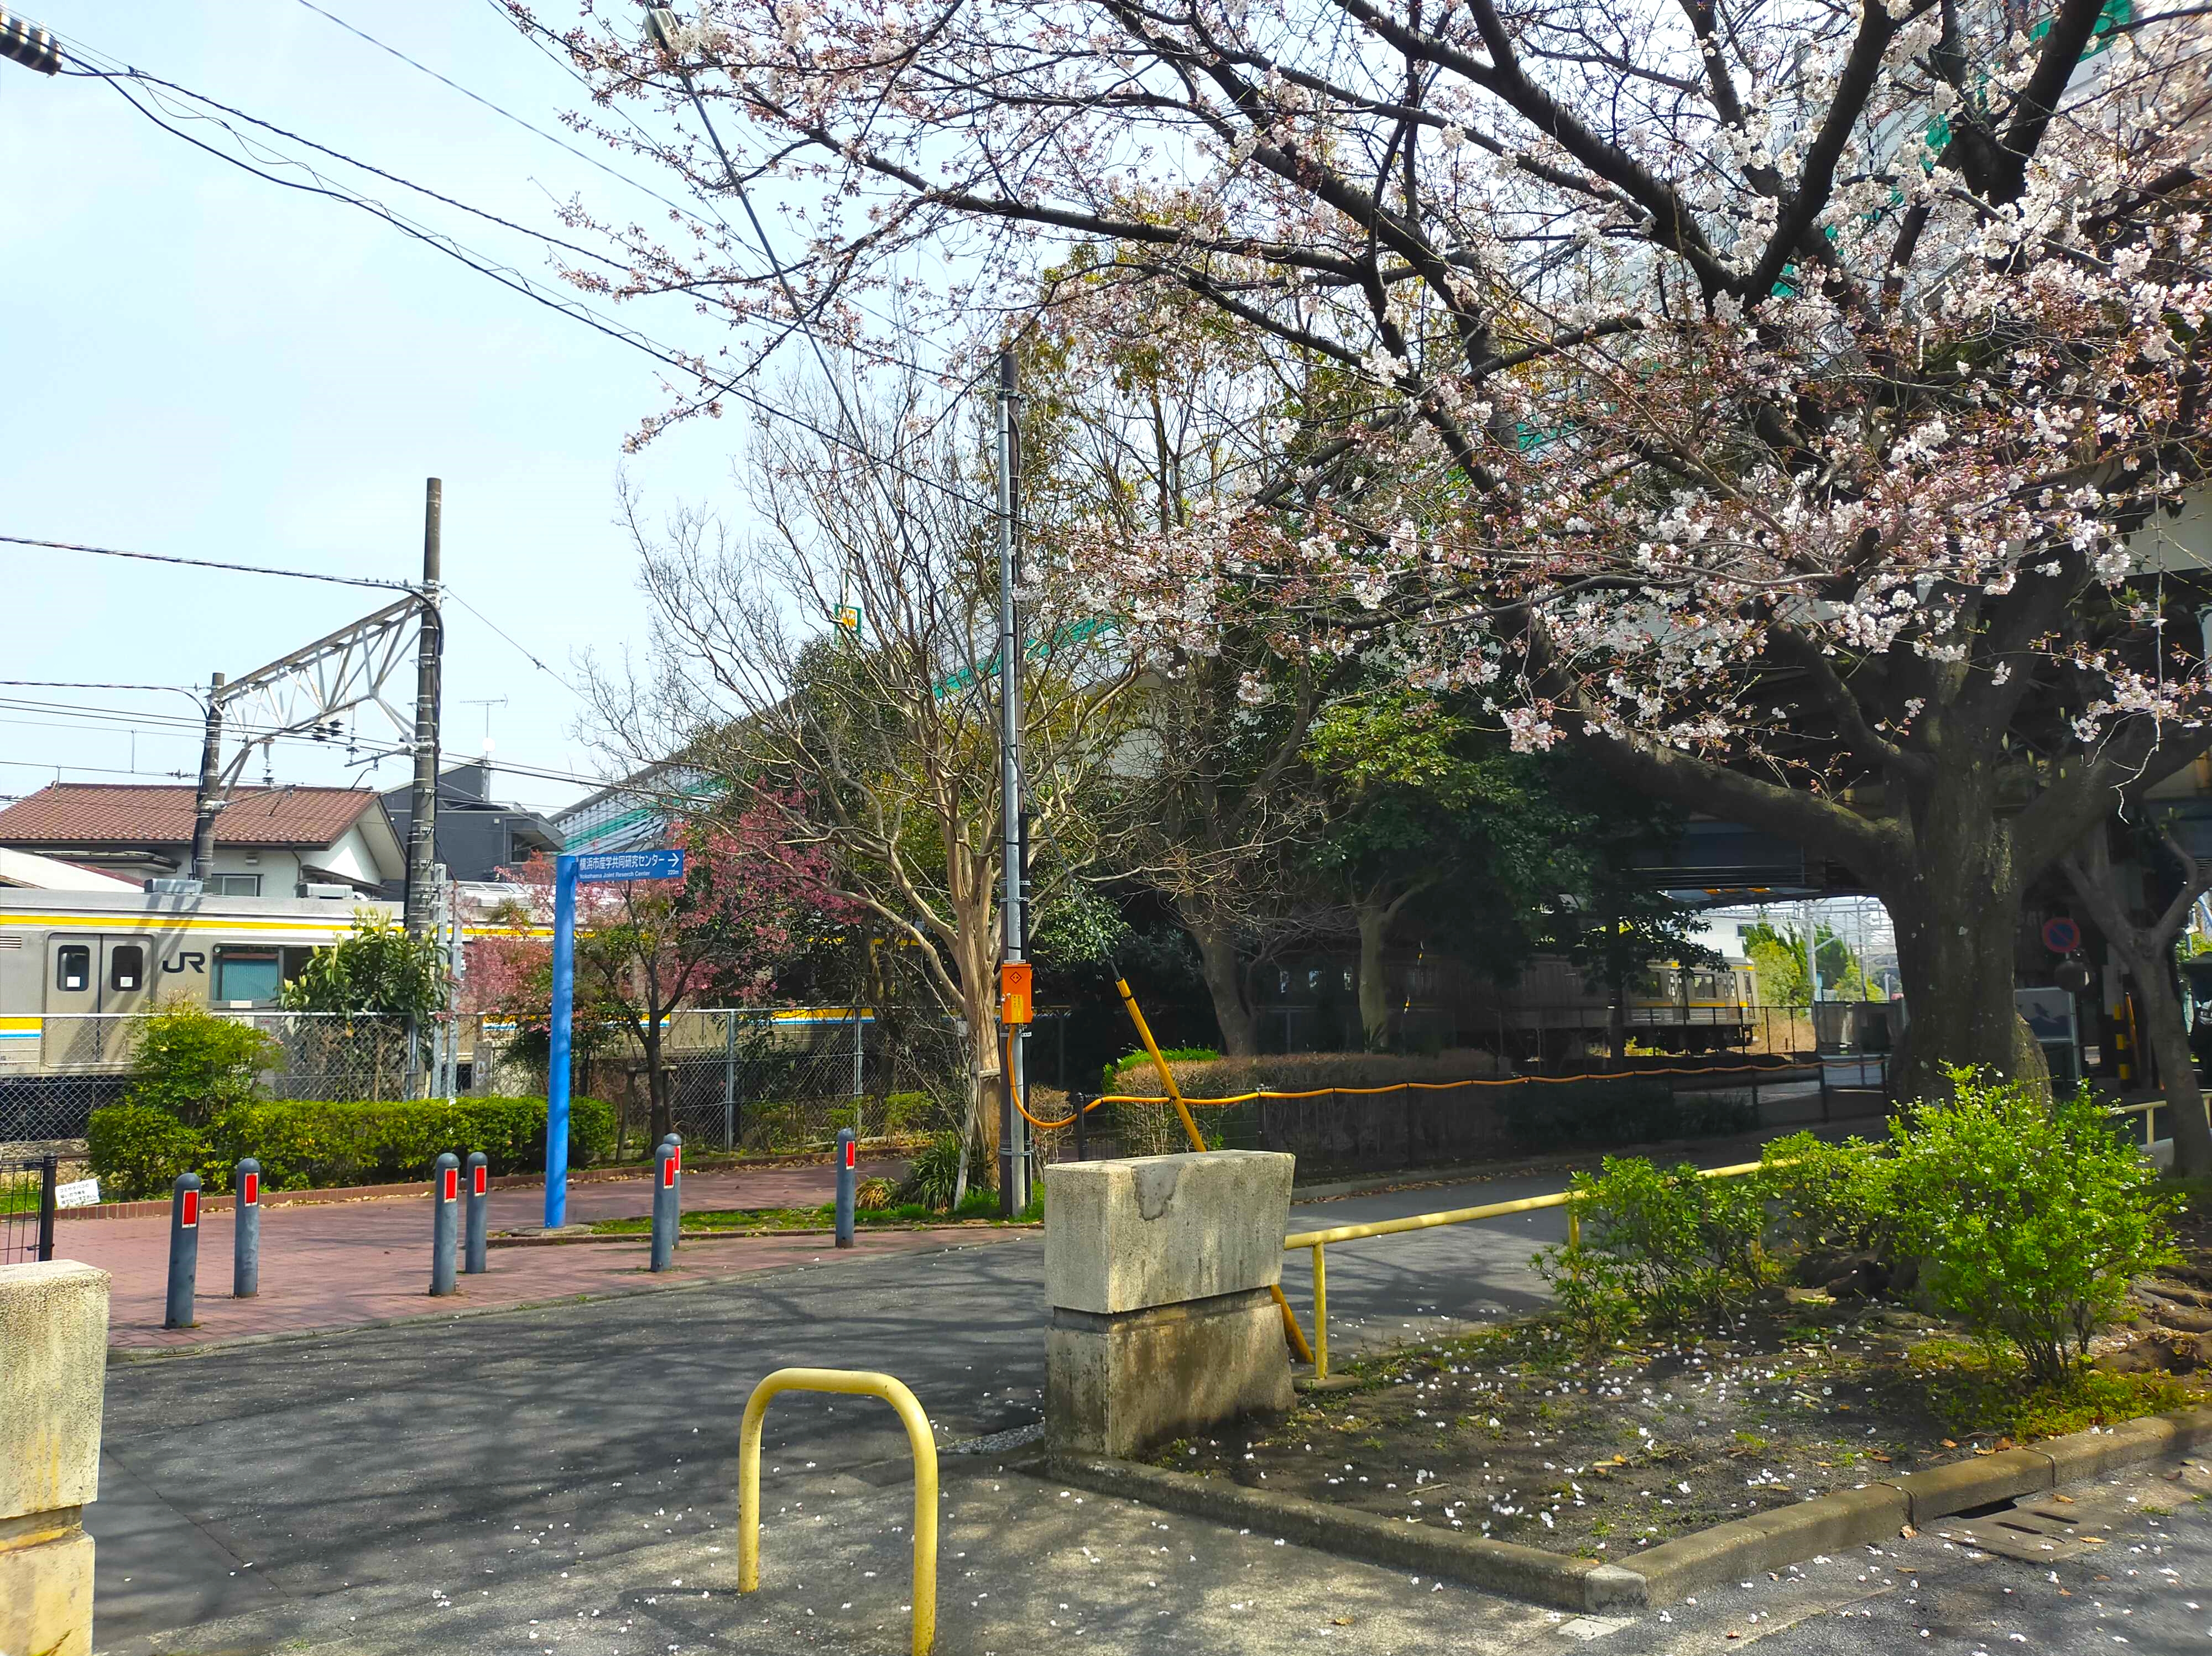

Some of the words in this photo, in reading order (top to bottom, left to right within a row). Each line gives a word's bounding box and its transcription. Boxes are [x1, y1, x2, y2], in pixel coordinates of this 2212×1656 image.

[580, 854, 665, 870] 横浜市産学共同研究センター
[163, 952, 205, 974] JR
